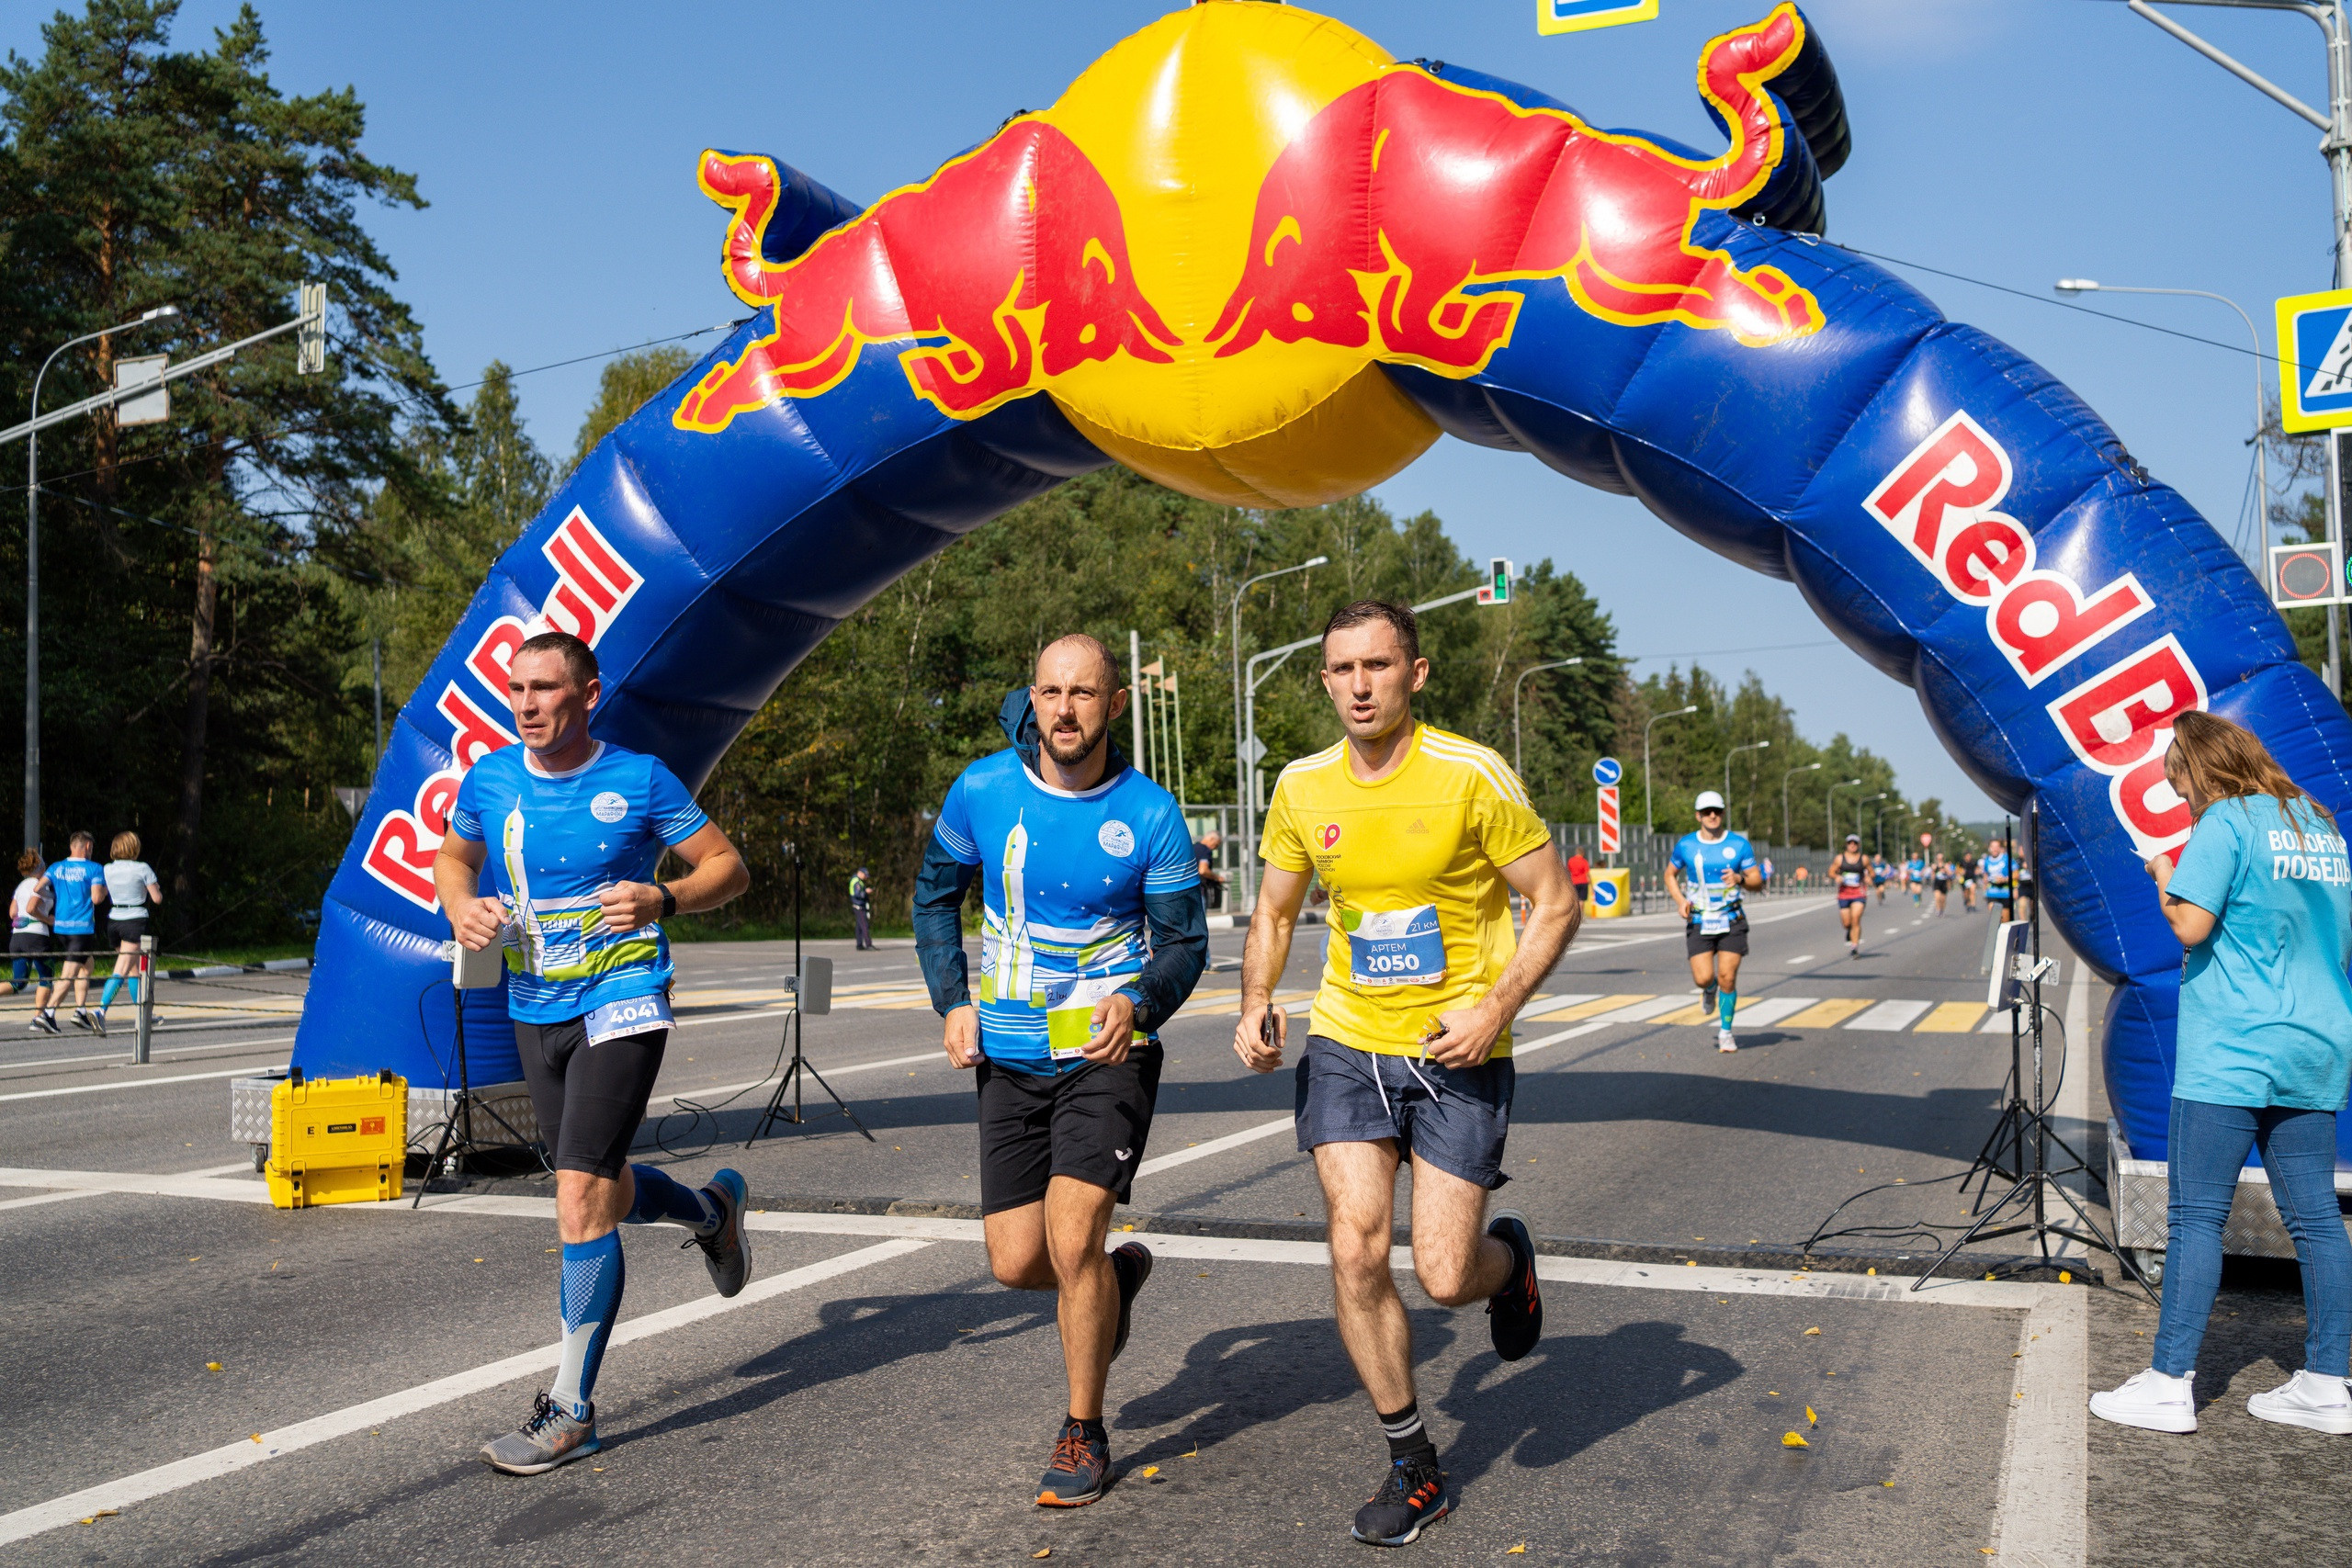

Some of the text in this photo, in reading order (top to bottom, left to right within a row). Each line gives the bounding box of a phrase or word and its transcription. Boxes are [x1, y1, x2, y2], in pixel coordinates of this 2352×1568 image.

[1873, 419, 2203, 869] Red Bu
[1410, 922, 1421, 932] 21
[1371, 942, 1407, 953] АРТЕМ
[1366, 953, 1420, 973] 2050
[610, 1002, 660, 1024] 4041
